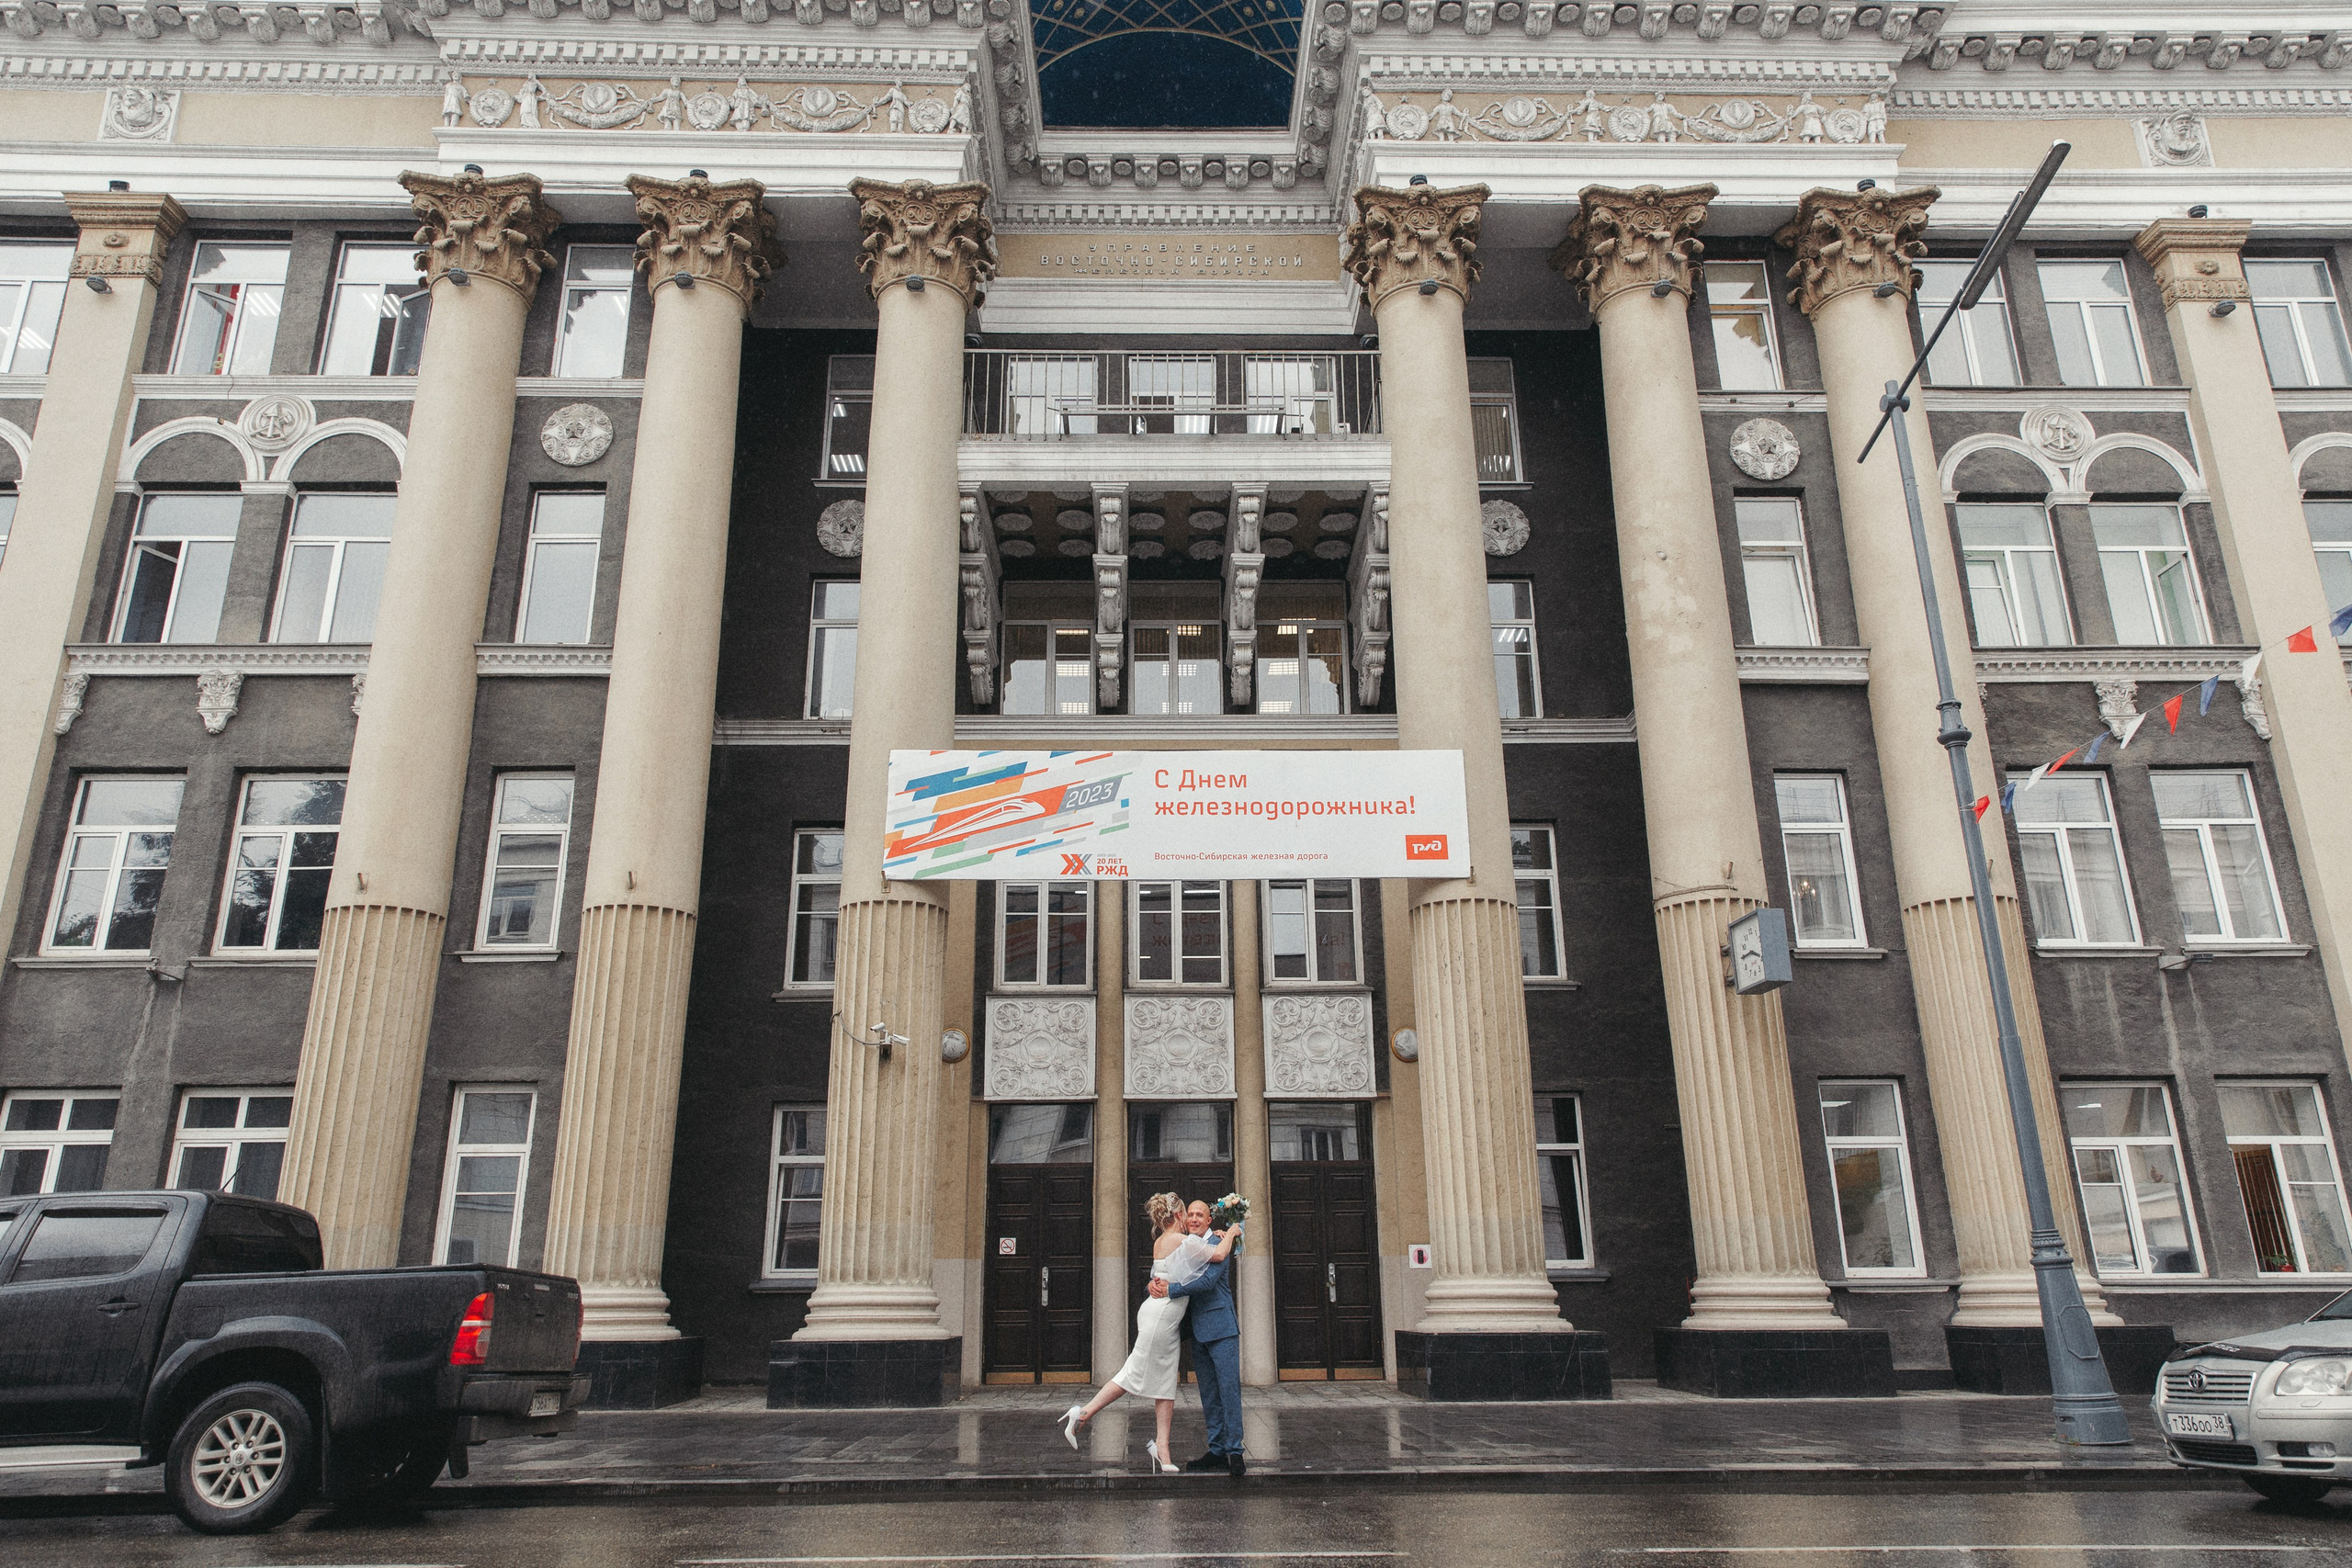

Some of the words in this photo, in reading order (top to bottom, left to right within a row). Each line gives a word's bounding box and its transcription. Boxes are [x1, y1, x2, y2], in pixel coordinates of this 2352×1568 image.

[1089, 243, 1255, 253] УПРАВЛЕНИЕ
[1040, 254, 1303, 266] ВОСТОЧНО-СИБИРСКОЙ
[1154, 769, 1170, 788] С
[1178, 769, 1248, 792] Днем
[1066, 782, 1114, 808] 2023
[1154, 795, 1416, 820] железнодорожника!
[1154, 852, 1248, 862] Восточно-Сибирская
[1296, 853, 1329, 862] дорога
[1096, 865, 1128, 877] РЖД
